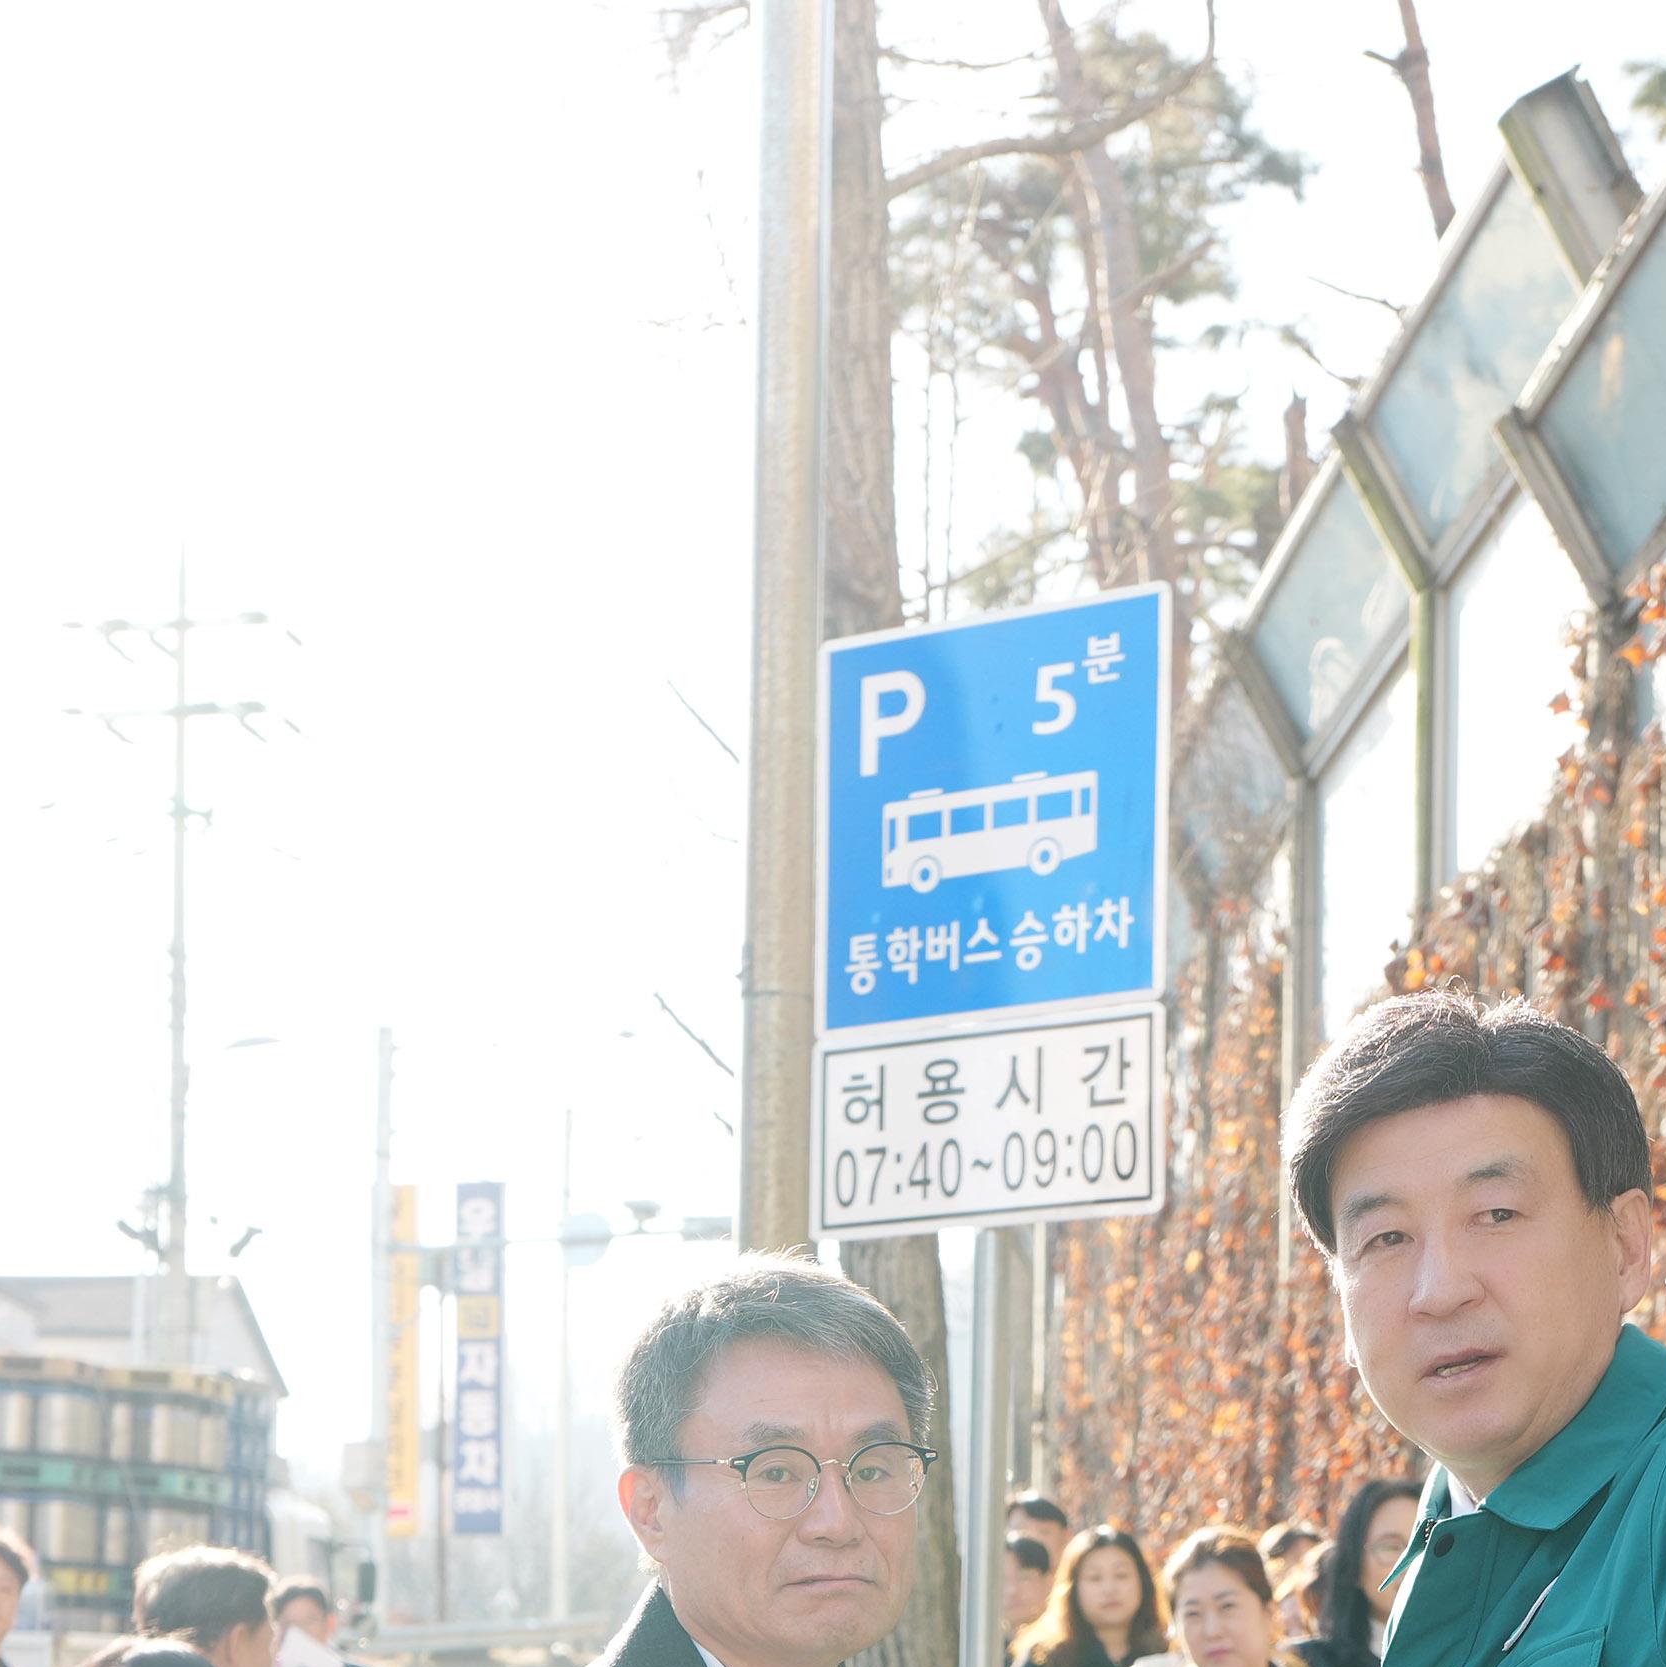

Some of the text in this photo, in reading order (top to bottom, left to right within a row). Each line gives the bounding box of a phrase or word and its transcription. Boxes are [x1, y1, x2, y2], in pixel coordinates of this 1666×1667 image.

[858, 671, 926, 777] P
[844, 896, 1134, 996] 통학버스 승하차
[834, 1120, 1139, 1209] 07:40~09:00
